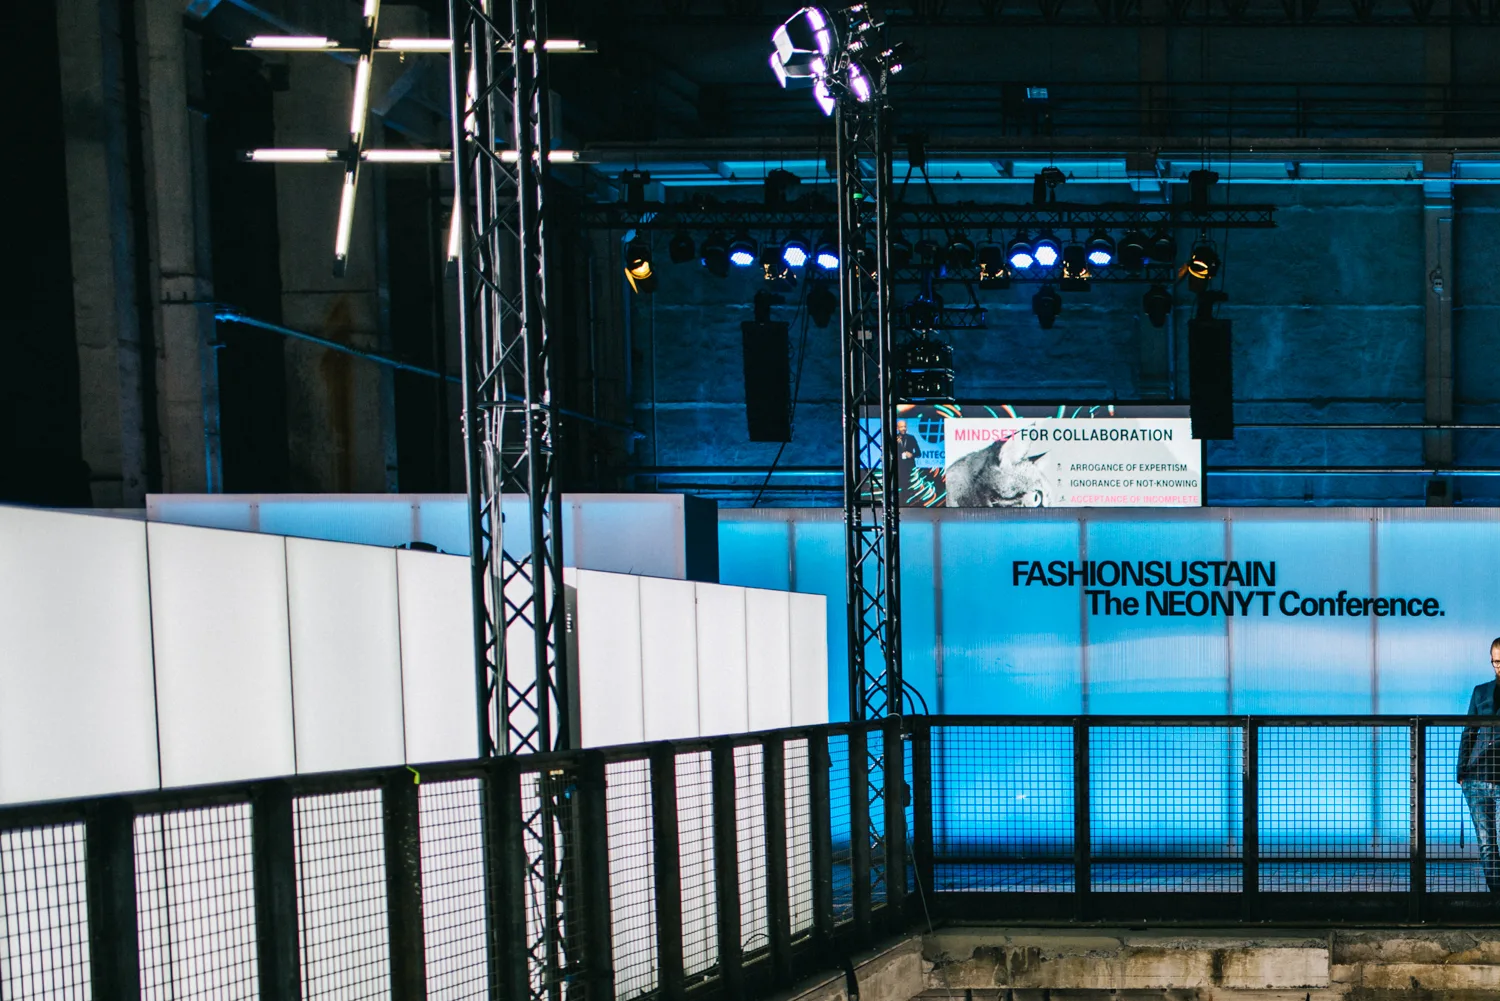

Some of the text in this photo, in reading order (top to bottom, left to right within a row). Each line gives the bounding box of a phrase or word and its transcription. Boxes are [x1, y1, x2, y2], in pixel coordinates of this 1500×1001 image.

[954, 429, 1173, 441] MINDSET FOR COLLABORATION
[1070, 463, 1188, 472] ARROGANCE OF EXPERTISM
[1070, 479, 1198, 488] IGNORANCE OF NOT-KNOWING
[1070, 495, 1199, 504] ACCEPTANCE OF INCOMPLETE
[1012, 561, 1276, 587] FASHIONSUSTAIN
[1084, 589, 1445, 616] The NEONYT Conference.
